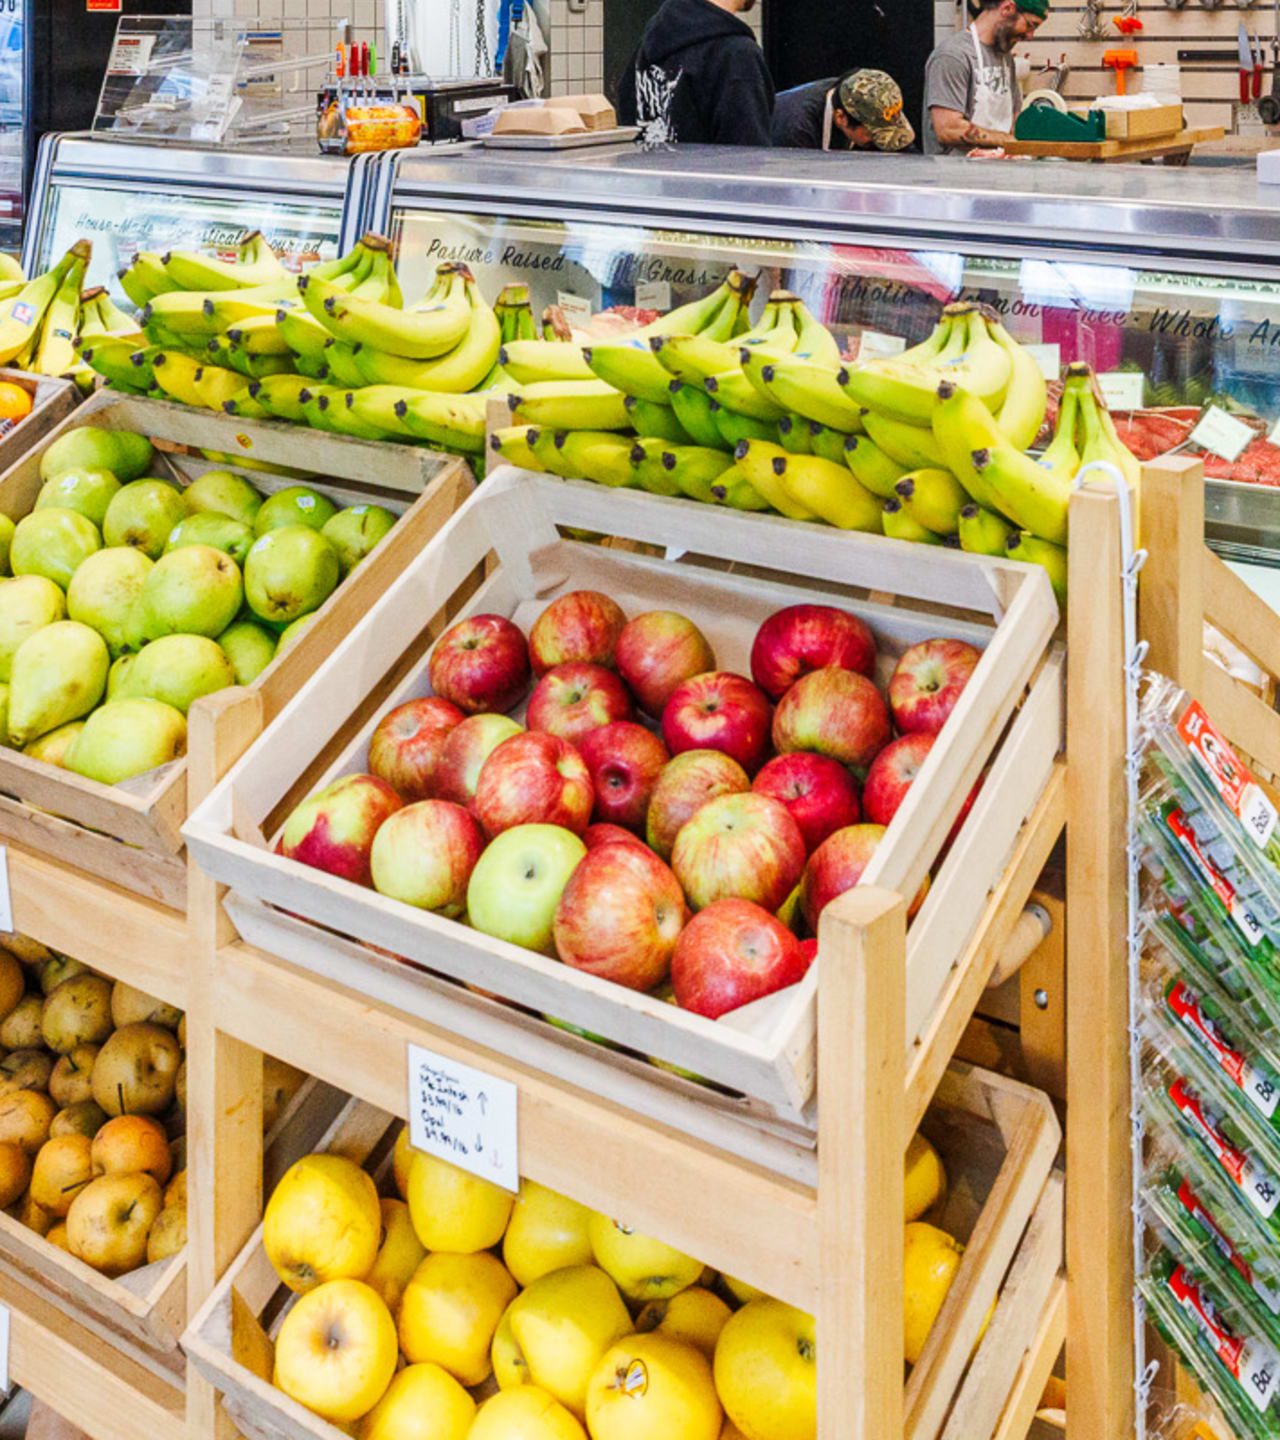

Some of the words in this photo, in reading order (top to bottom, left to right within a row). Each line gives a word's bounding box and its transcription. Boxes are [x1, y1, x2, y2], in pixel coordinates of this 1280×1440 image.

[426, 237, 495, 267] Pasture
[501, 243, 566, 274] Raised
[1148, 307, 1234, 343] Whole
